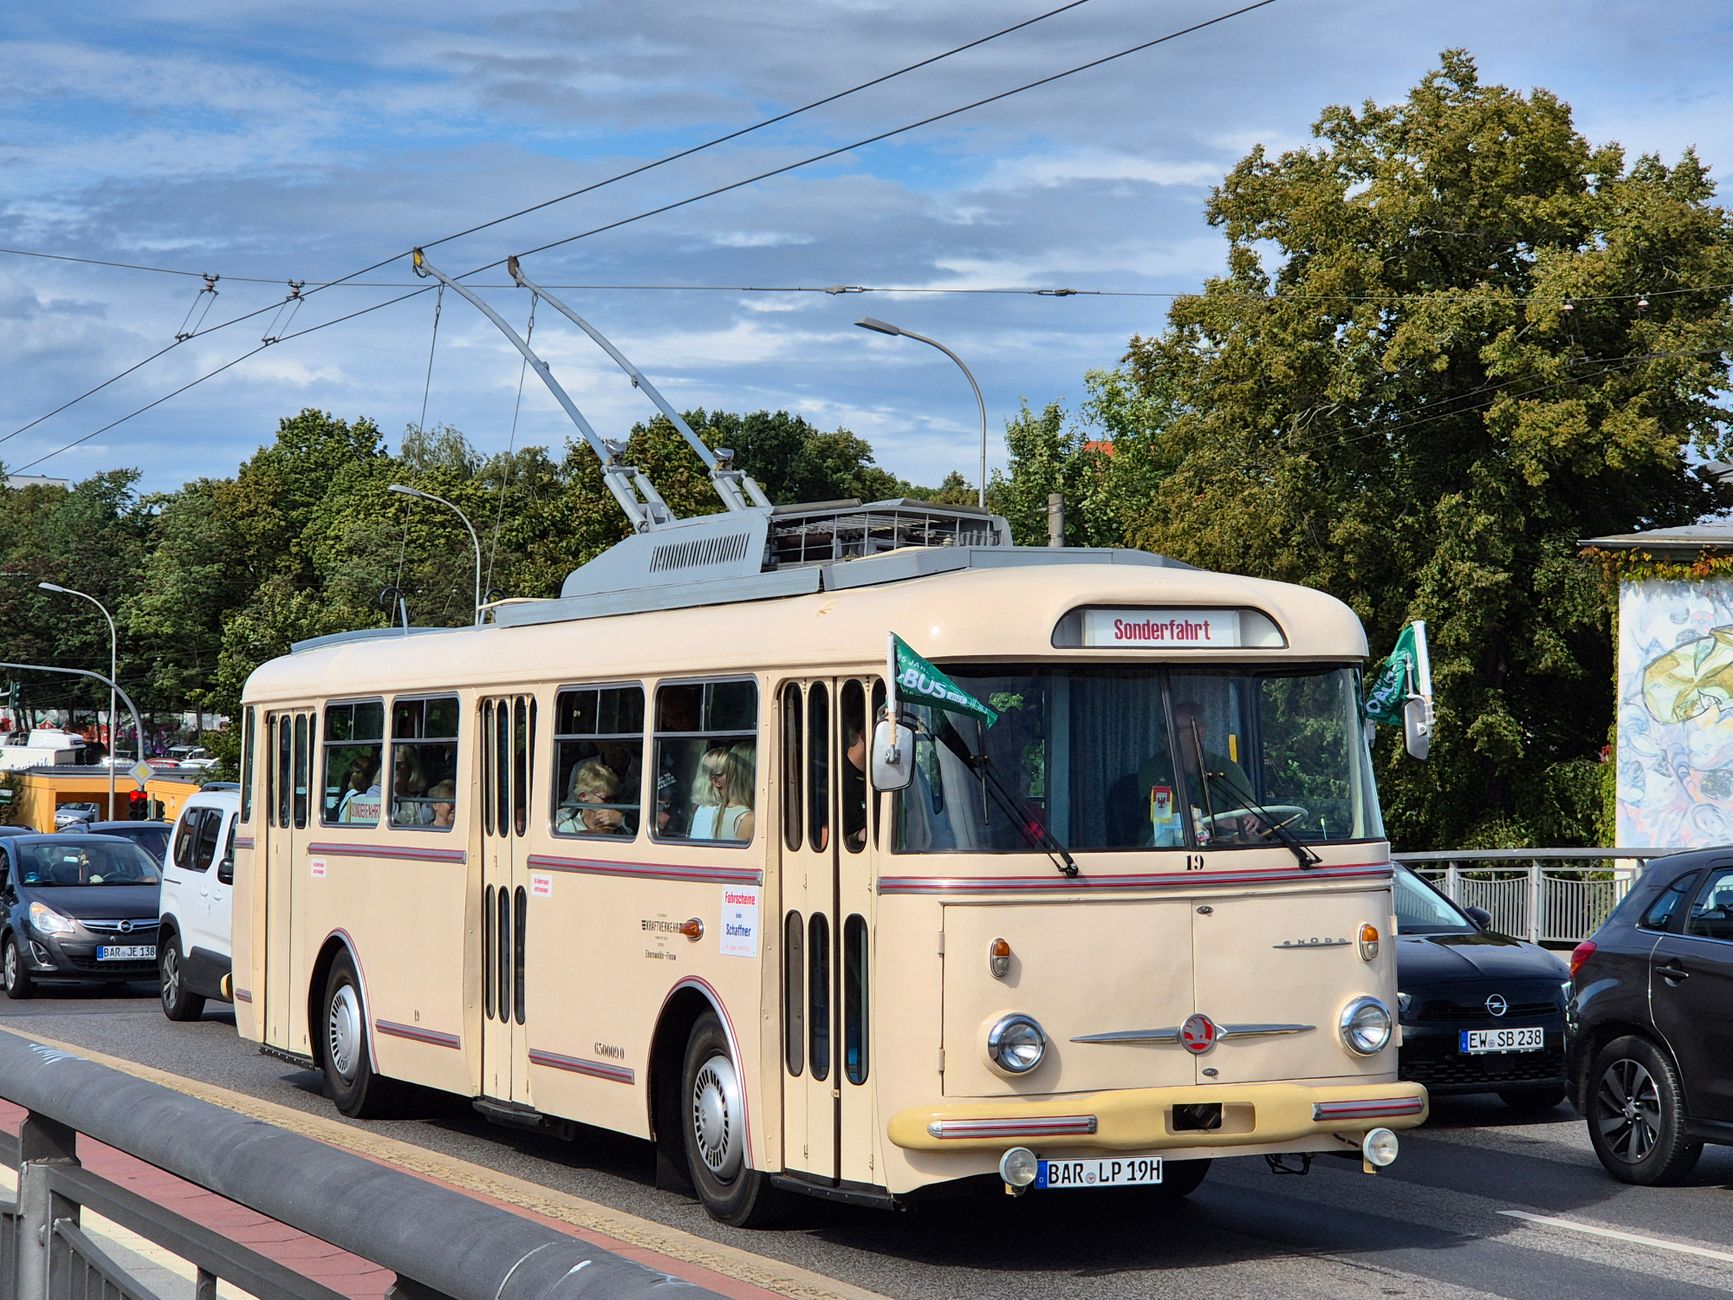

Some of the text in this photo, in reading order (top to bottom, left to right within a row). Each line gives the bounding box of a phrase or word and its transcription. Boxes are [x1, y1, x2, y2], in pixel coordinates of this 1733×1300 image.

[1114, 618, 1211, 640] Sonderfahrt
[1186, 854, 1205, 871] 19
[725, 891, 756, 905] Fahrscheine
[726, 923, 751, 937] Schaffner
[104, 946, 155, 957] BAR JE 138
[1469, 1029, 1541, 1048] EW SB 238
[1048, 1163, 1084, 1184] BAR
[1099, 1162, 1122, 1182] LP
[1127, 1160, 1160, 1181] 19H
